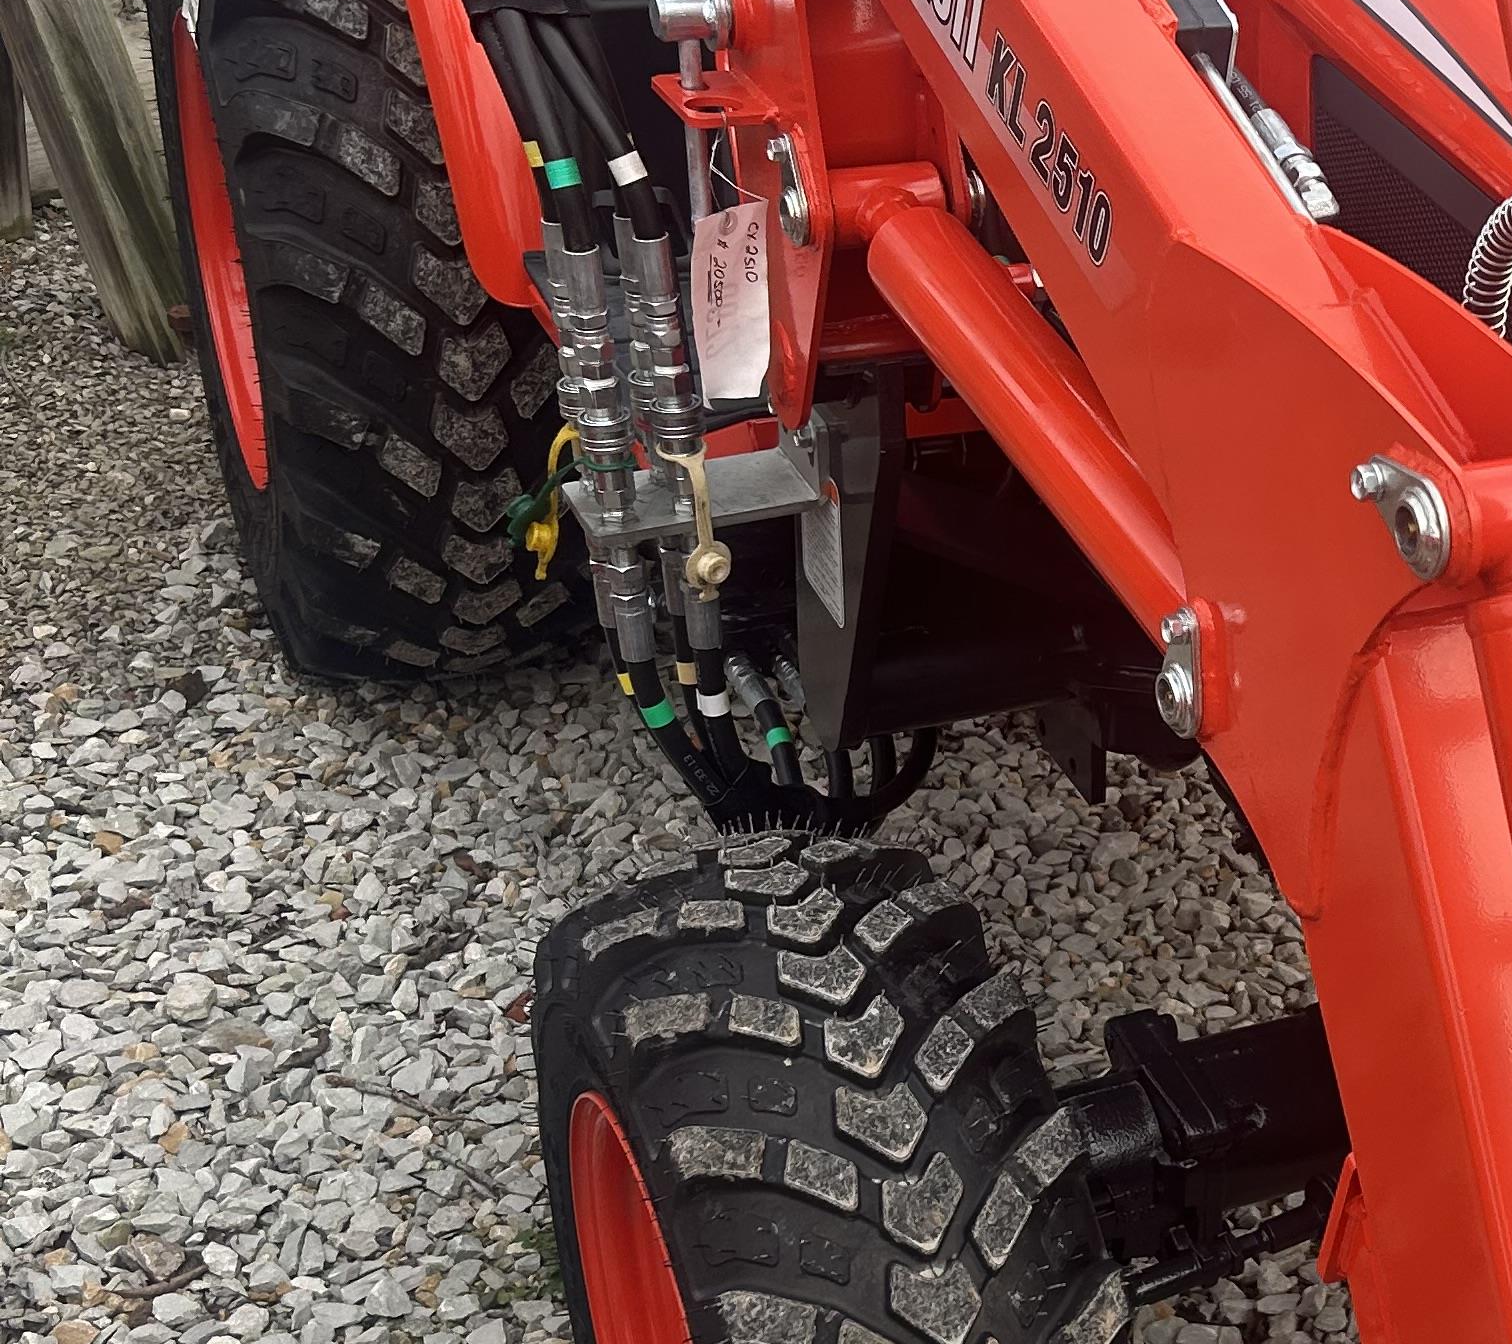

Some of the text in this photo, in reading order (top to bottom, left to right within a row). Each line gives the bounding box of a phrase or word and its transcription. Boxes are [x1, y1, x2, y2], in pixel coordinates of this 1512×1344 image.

[986, 29, 1027, 150] KL
[1029, 98, 1113, 266] 2510
[743, 245, 759, 284] 2510
